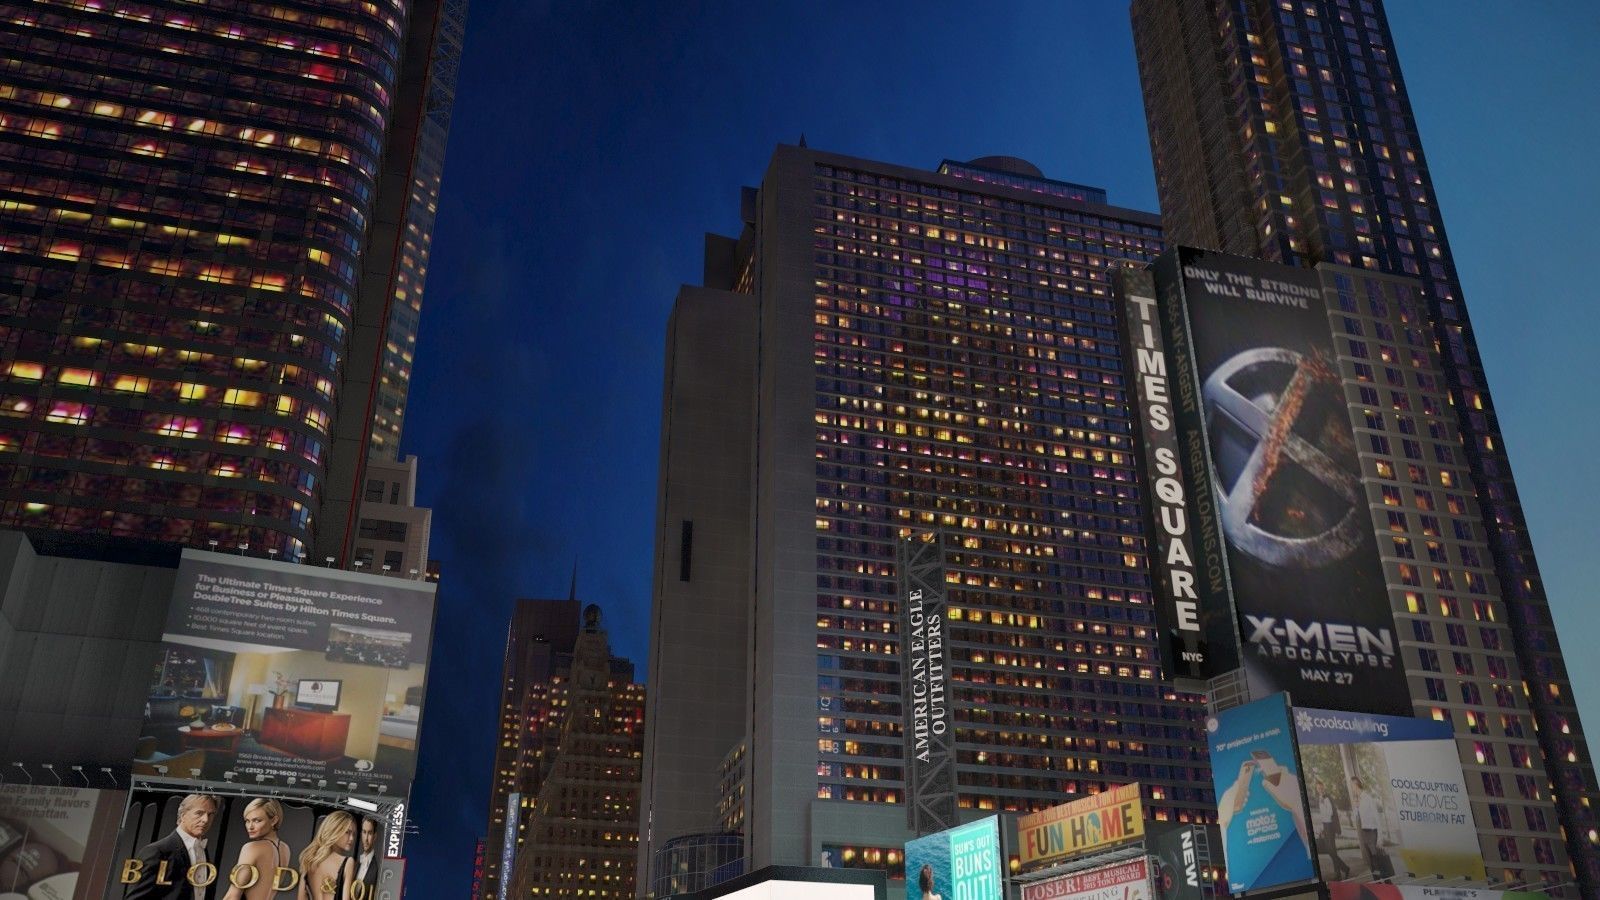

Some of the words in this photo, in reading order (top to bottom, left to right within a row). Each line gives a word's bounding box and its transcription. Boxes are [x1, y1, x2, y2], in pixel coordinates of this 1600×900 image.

[1184, 265, 1219, 281] ONLY
[1225, 272, 1253, 288] THE
[1261, 277, 1320, 299] STRONG
[1204, 282, 1240, 297] WILL
[1246, 288, 1309, 309] SURVIVE
[1130, 295, 1170, 431] TIMES
[1155, 447, 1200, 632] SQUARE
[195, 583, 211, 591] for
[212, 585, 256, 598] Business
[270, 592, 314, 605] Pleasure.
[198, 574, 217, 584] The
[218, 576, 262, 589] Ultimate
[264, 582, 293, 593] Times
[293, 587, 329, 600] Square
[330, 591, 383, 605] Experience
[193, 591, 252, 605] DoubleTree
[253, 599, 284, 610] Suites
[285, 602, 297, 613] by
[300, 605, 329, 615] Hilton
[331, 609, 360, 619] Times
[361, 613, 397, 625] Square.
[910, 589, 925, 651] EAGLE
[1245, 614, 1395, 656] X-MEN
[1182, 651, 1204, 663] NYC
[1257, 644, 1393, 669] APOCALYPSE
[927, 614, 946, 735] OUTFITTERS
[1300, 669, 1330, 684] MAY
[1334, 672, 1353, 685] 27
[912, 657, 930, 763] AMERICAN
[245, 767, 264, 775] (212)
[1391, 779, 1459, 792] COOLSCULPTING
[1401, 793, 1458, 810] REMOVES
[1400, 810, 1448, 824] STUBBORN
[1451, 814, 1465, 824] FAT
[954, 839, 975, 856] SUN'S
[976, 835, 991, 849] OUT
[1026, 821, 1064, 859] FUN
[955, 849, 992, 879] BUNS
[1180, 830, 1199, 887] NEW
[120, 858, 299, 892] BLOOD
[320, 876, 337, 894] &
[956, 873, 994, 900] OUT!
[1083, 872, 1101, 883] BEST
[1103, 863, 1140, 879] MUSICAL!
[1115, 871, 1141, 884] AWARD
[1026, 878, 1081, 900] LOSER!
